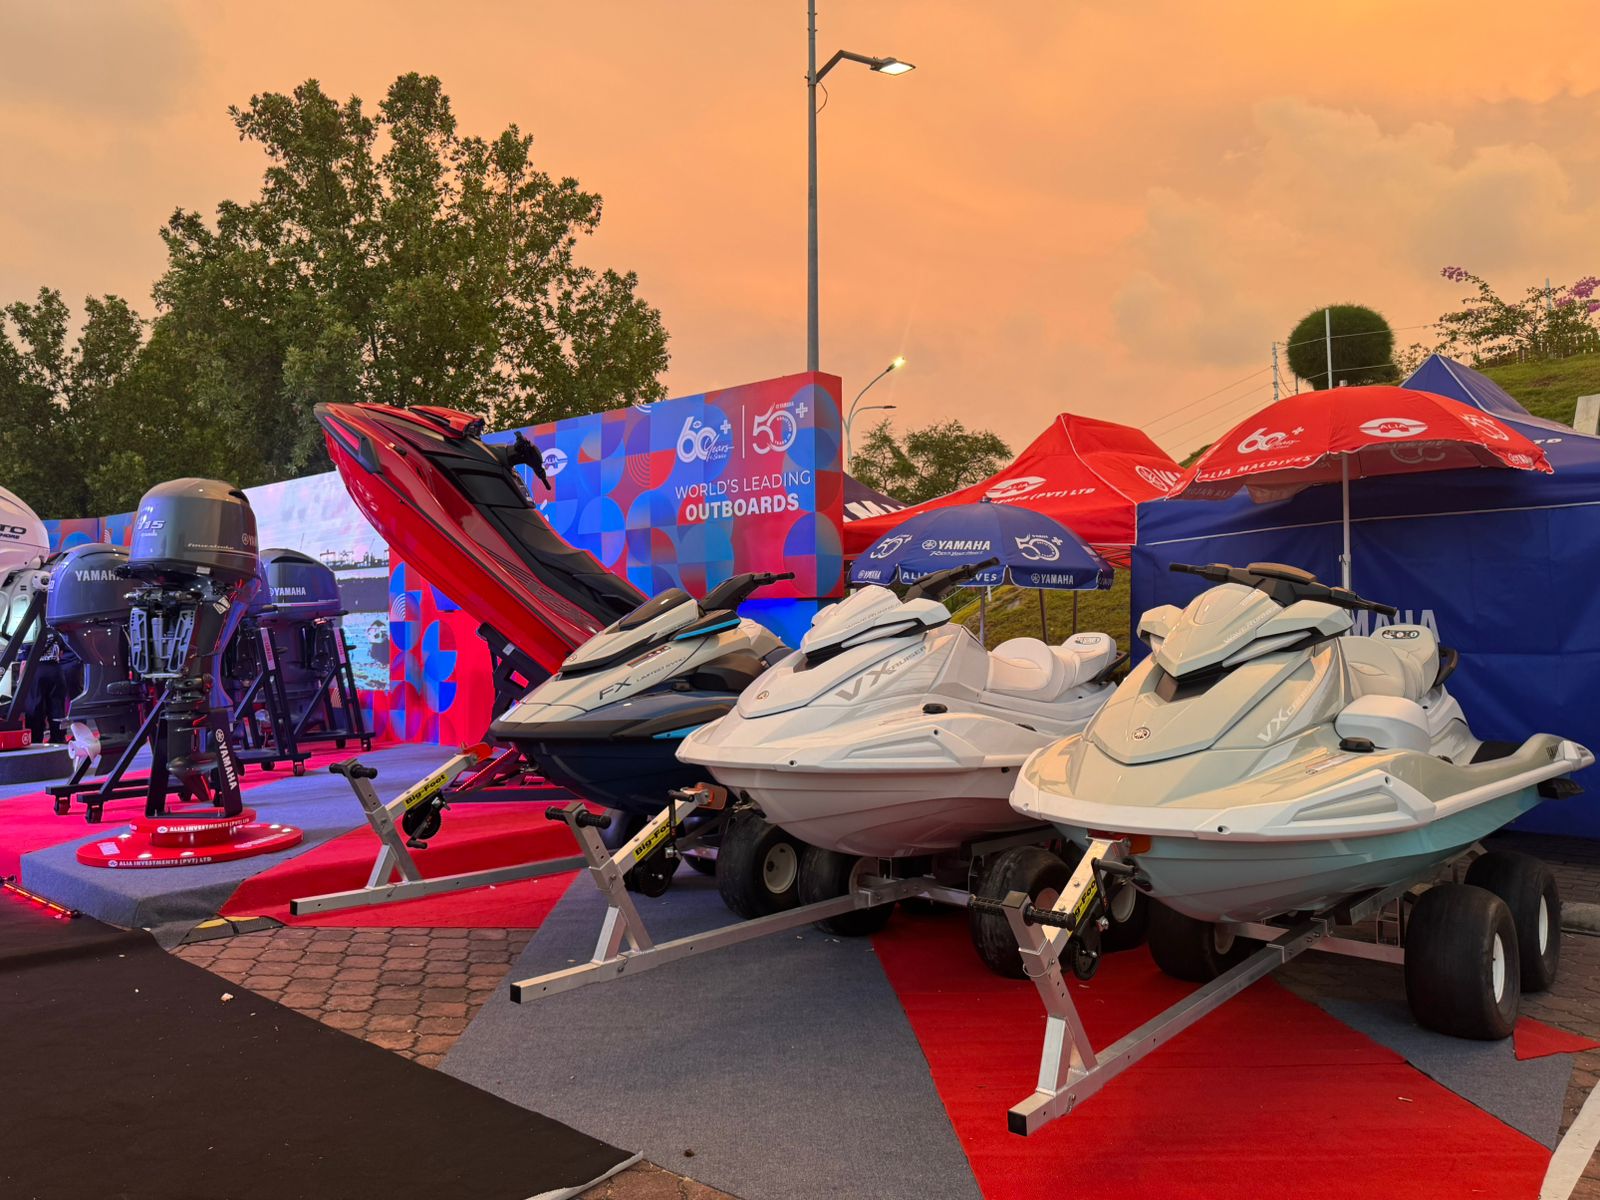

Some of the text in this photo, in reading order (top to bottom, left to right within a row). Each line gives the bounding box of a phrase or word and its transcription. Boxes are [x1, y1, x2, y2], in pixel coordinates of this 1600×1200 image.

[1380, 423, 1407, 431] ALIA
[1200, 469, 1232, 479] ALIA
[675, 470, 811, 499] WORLD'S LEADING
[1070, 487, 1095, 496] LTD
[685, 492, 800, 521] OUTBOARDS
[938, 540, 991, 551] YAMAHA
[1041, 574, 1074, 585] YAMAHA
[274, 587, 306, 596] YAMAHA
[835, 660, 896, 701] VX
[600, 676, 632, 700] FX
[1257, 706, 1288, 742] VX
[219, 741, 238, 790] YAMAHA
[405, 774, 446, 804] Big-Foot
[185, 822, 228, 832] INVESTMENTS
[133, 859, 178, 867] INVESTMENTS
[179, 857, 199, 866] (PVT)
